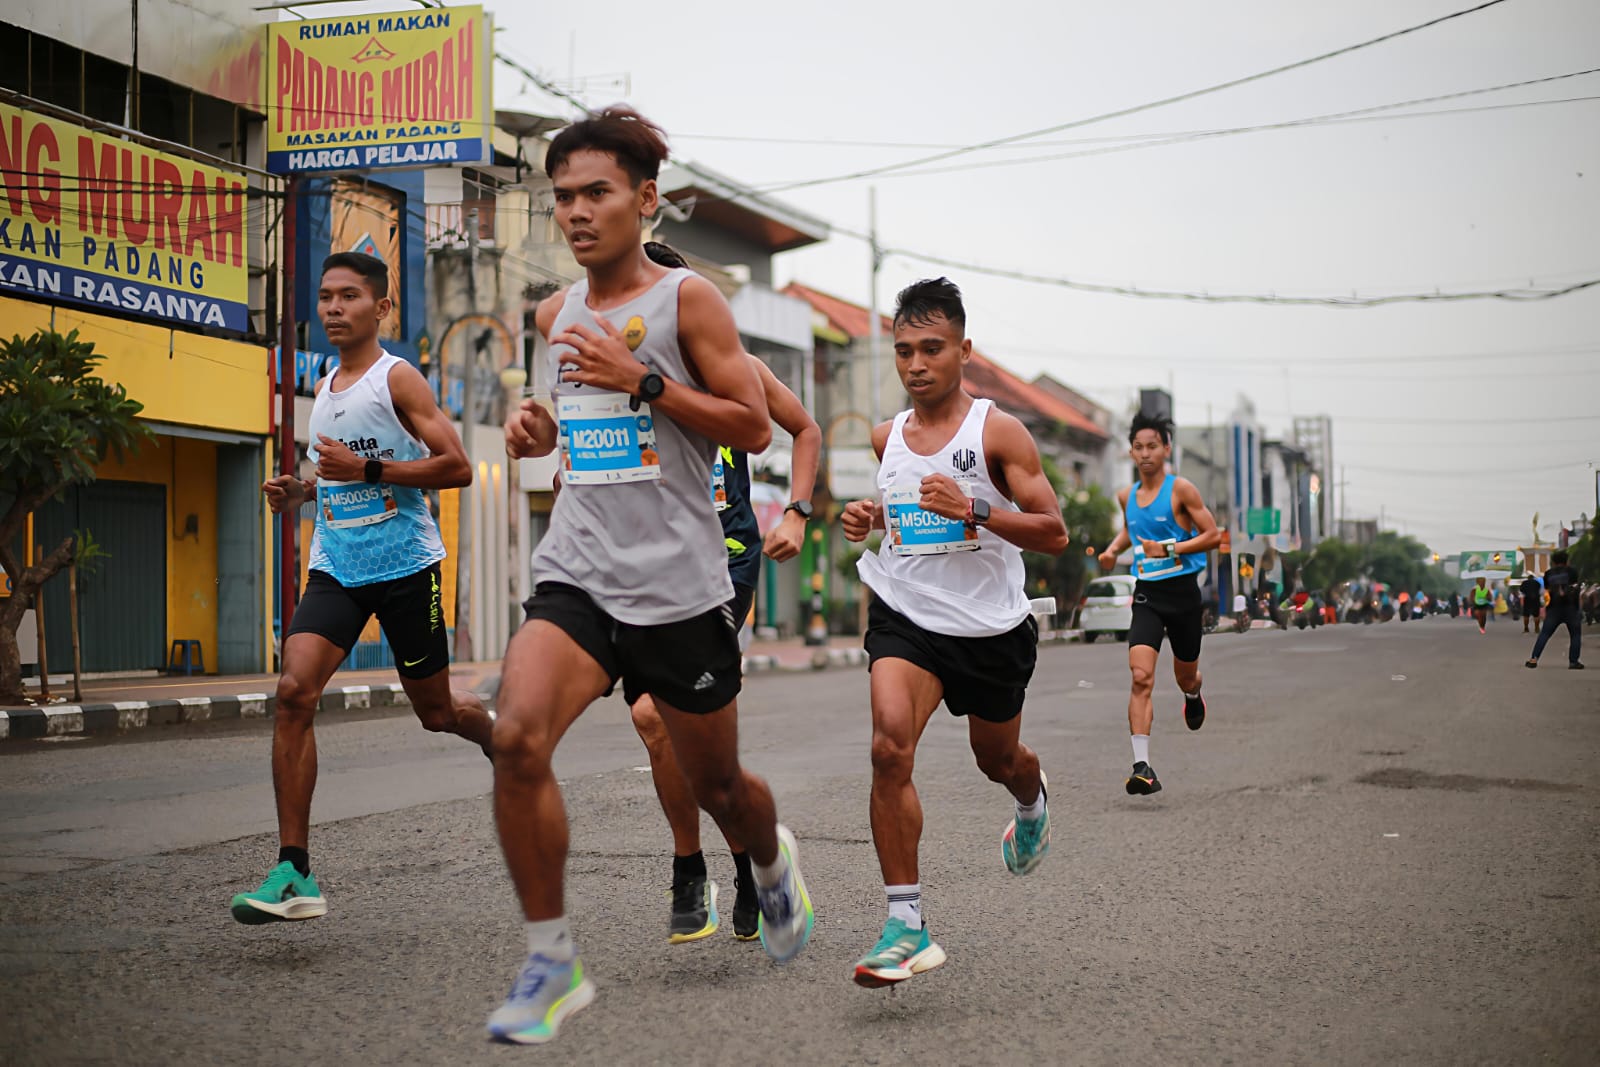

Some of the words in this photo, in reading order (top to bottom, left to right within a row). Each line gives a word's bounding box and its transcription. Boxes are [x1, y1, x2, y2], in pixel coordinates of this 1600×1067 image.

[300, 20, 370, 40] RUMAH
[377, 13, 450, 33] MAKAN
[276, 33, 374, 133] PADANG
[381, 17, 474, 125] MURAH
[286, 130, 379, 146] MASAKAN
[385, 121, 461, 140] PADANG
[288, 149, 360, 170] HARGA
[365, 141, 458, 164] PELAJAR
[78, 135, 243, 268] MURAH
[83, 236, 204, 289] PADANG
[73, 275, 226, 328] RASANYA
[573, 427, 630, 449] M20011
[952, 448, 977, 473] KWR
[330, 487, 379, 506] M50035
